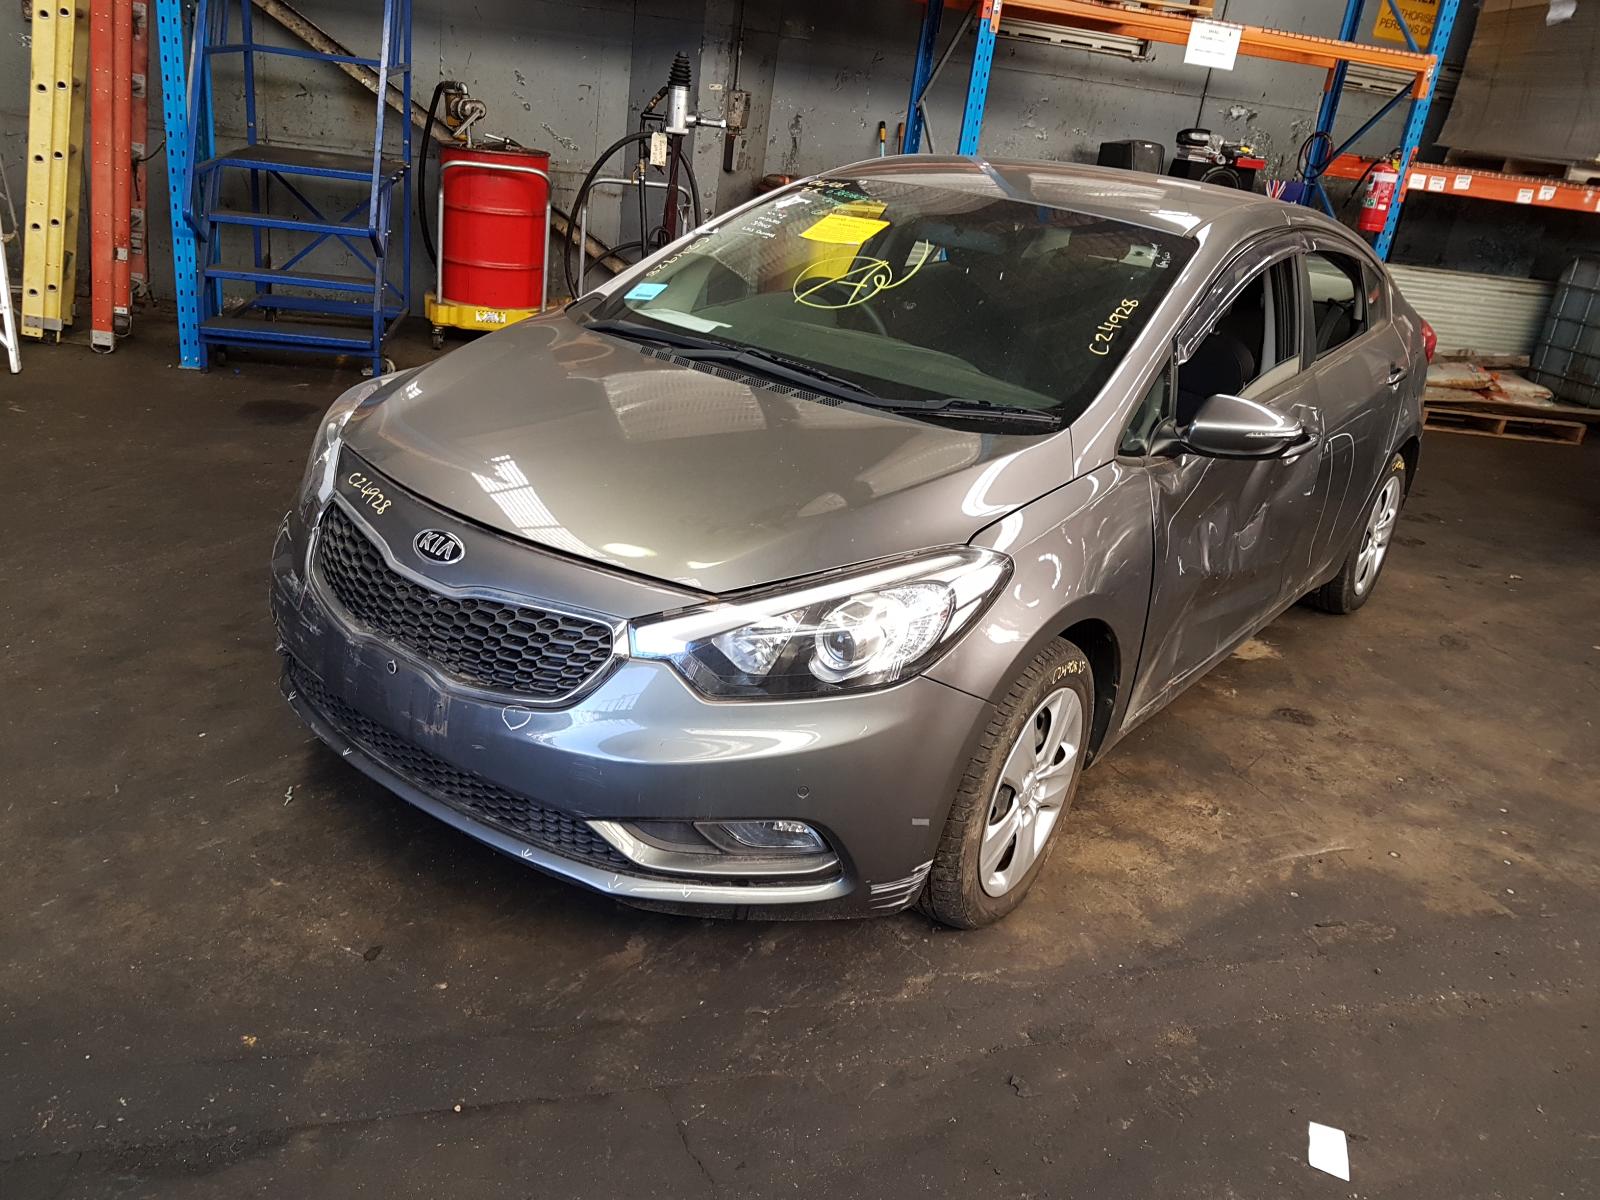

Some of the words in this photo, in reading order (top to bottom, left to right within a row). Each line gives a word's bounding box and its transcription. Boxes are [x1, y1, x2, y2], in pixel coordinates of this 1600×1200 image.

[1379, 18, 1420, 34] PERSNS
[1088, 298, 1139, 356] C24928
[348, 472, 392, 515] C24928
[418, 531, 456, 561] KIA
